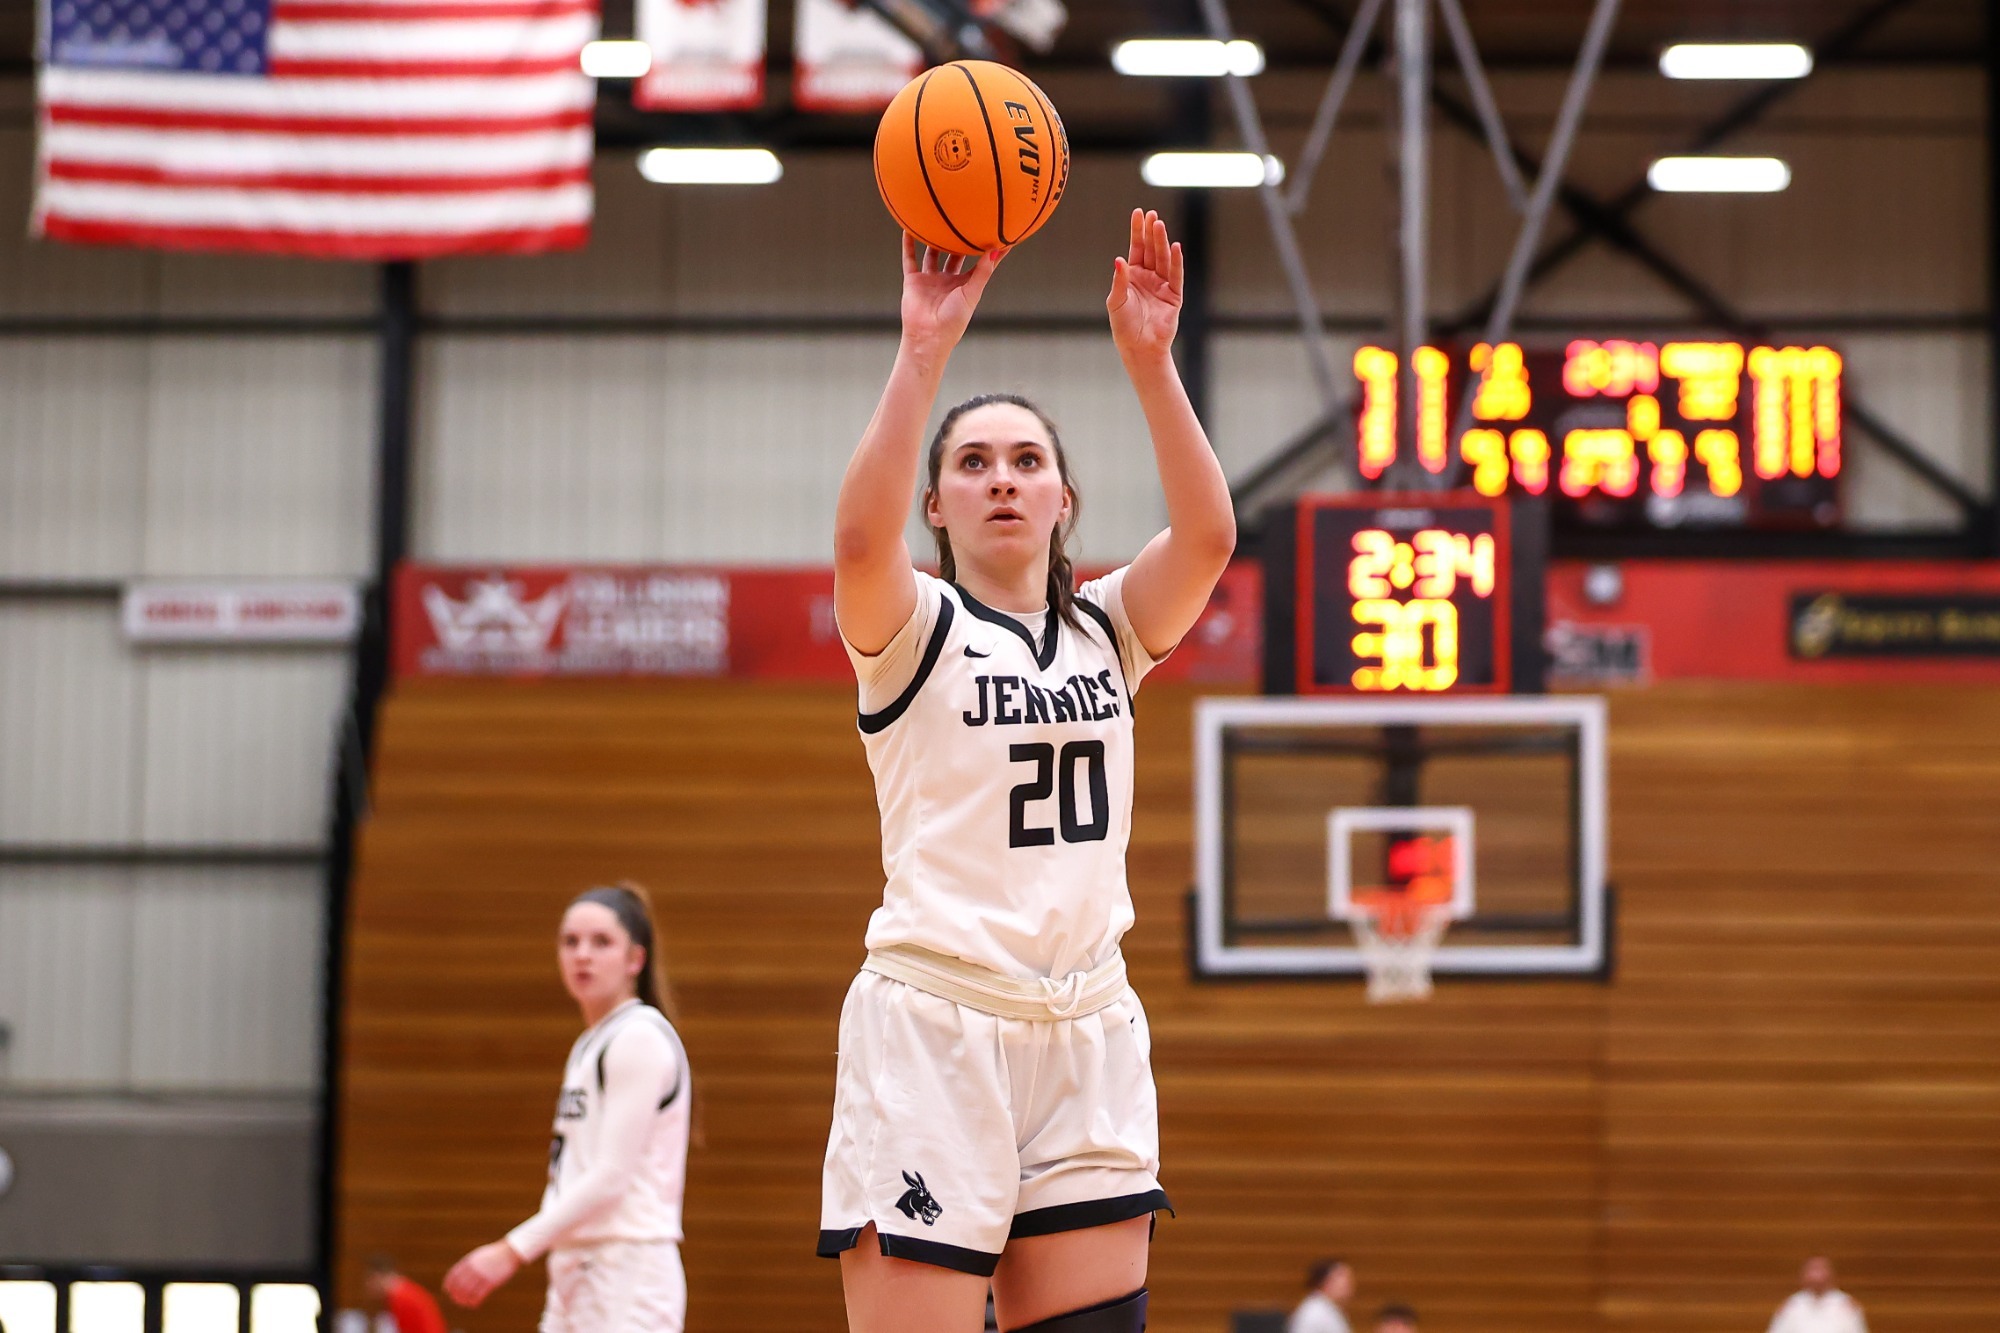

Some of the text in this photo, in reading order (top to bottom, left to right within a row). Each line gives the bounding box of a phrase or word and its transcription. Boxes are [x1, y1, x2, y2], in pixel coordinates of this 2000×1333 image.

[1003, 100, 1040, 203] EVO NXT
[1348, 529, 1495, 598] 2:34
[1351, 598, 1458, 691] 30
[962, 668, 1120, 727] JENNIES
[1009, 739, 1110, 849] 20
